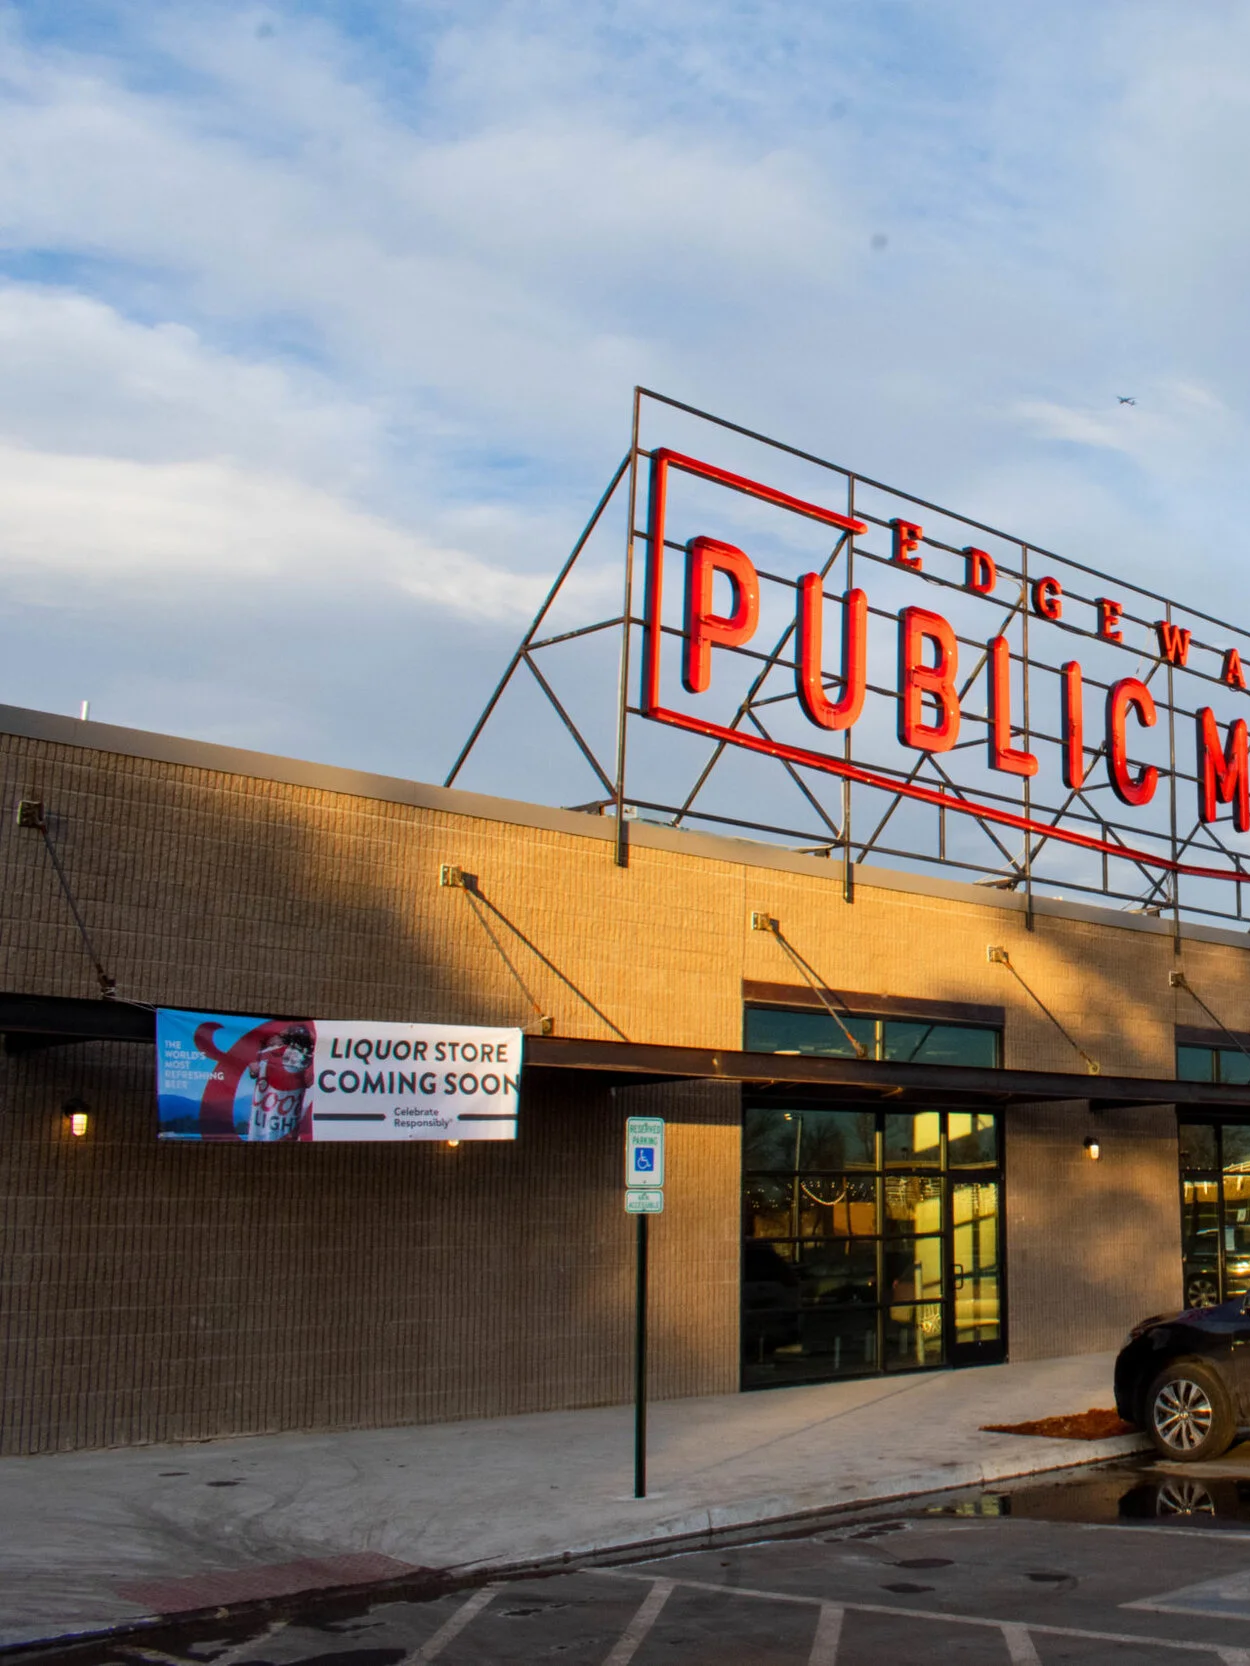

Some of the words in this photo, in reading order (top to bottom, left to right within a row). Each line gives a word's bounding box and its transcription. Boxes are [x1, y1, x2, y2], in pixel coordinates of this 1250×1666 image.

[682, 535, 1158, 806] PUBLIC
[164, 1040, 181, 1049] THE
[330, 1037, 428, 1065] LIQUOR
[434, 1042, 508, 1062] STORE
[164, 1060, 191, 1069] MOST
[318, 1069, 437, 1095] COMING
[443, 1072, 520, 1095] SOON
[394, 1107, 439, 1116] Celebrate
